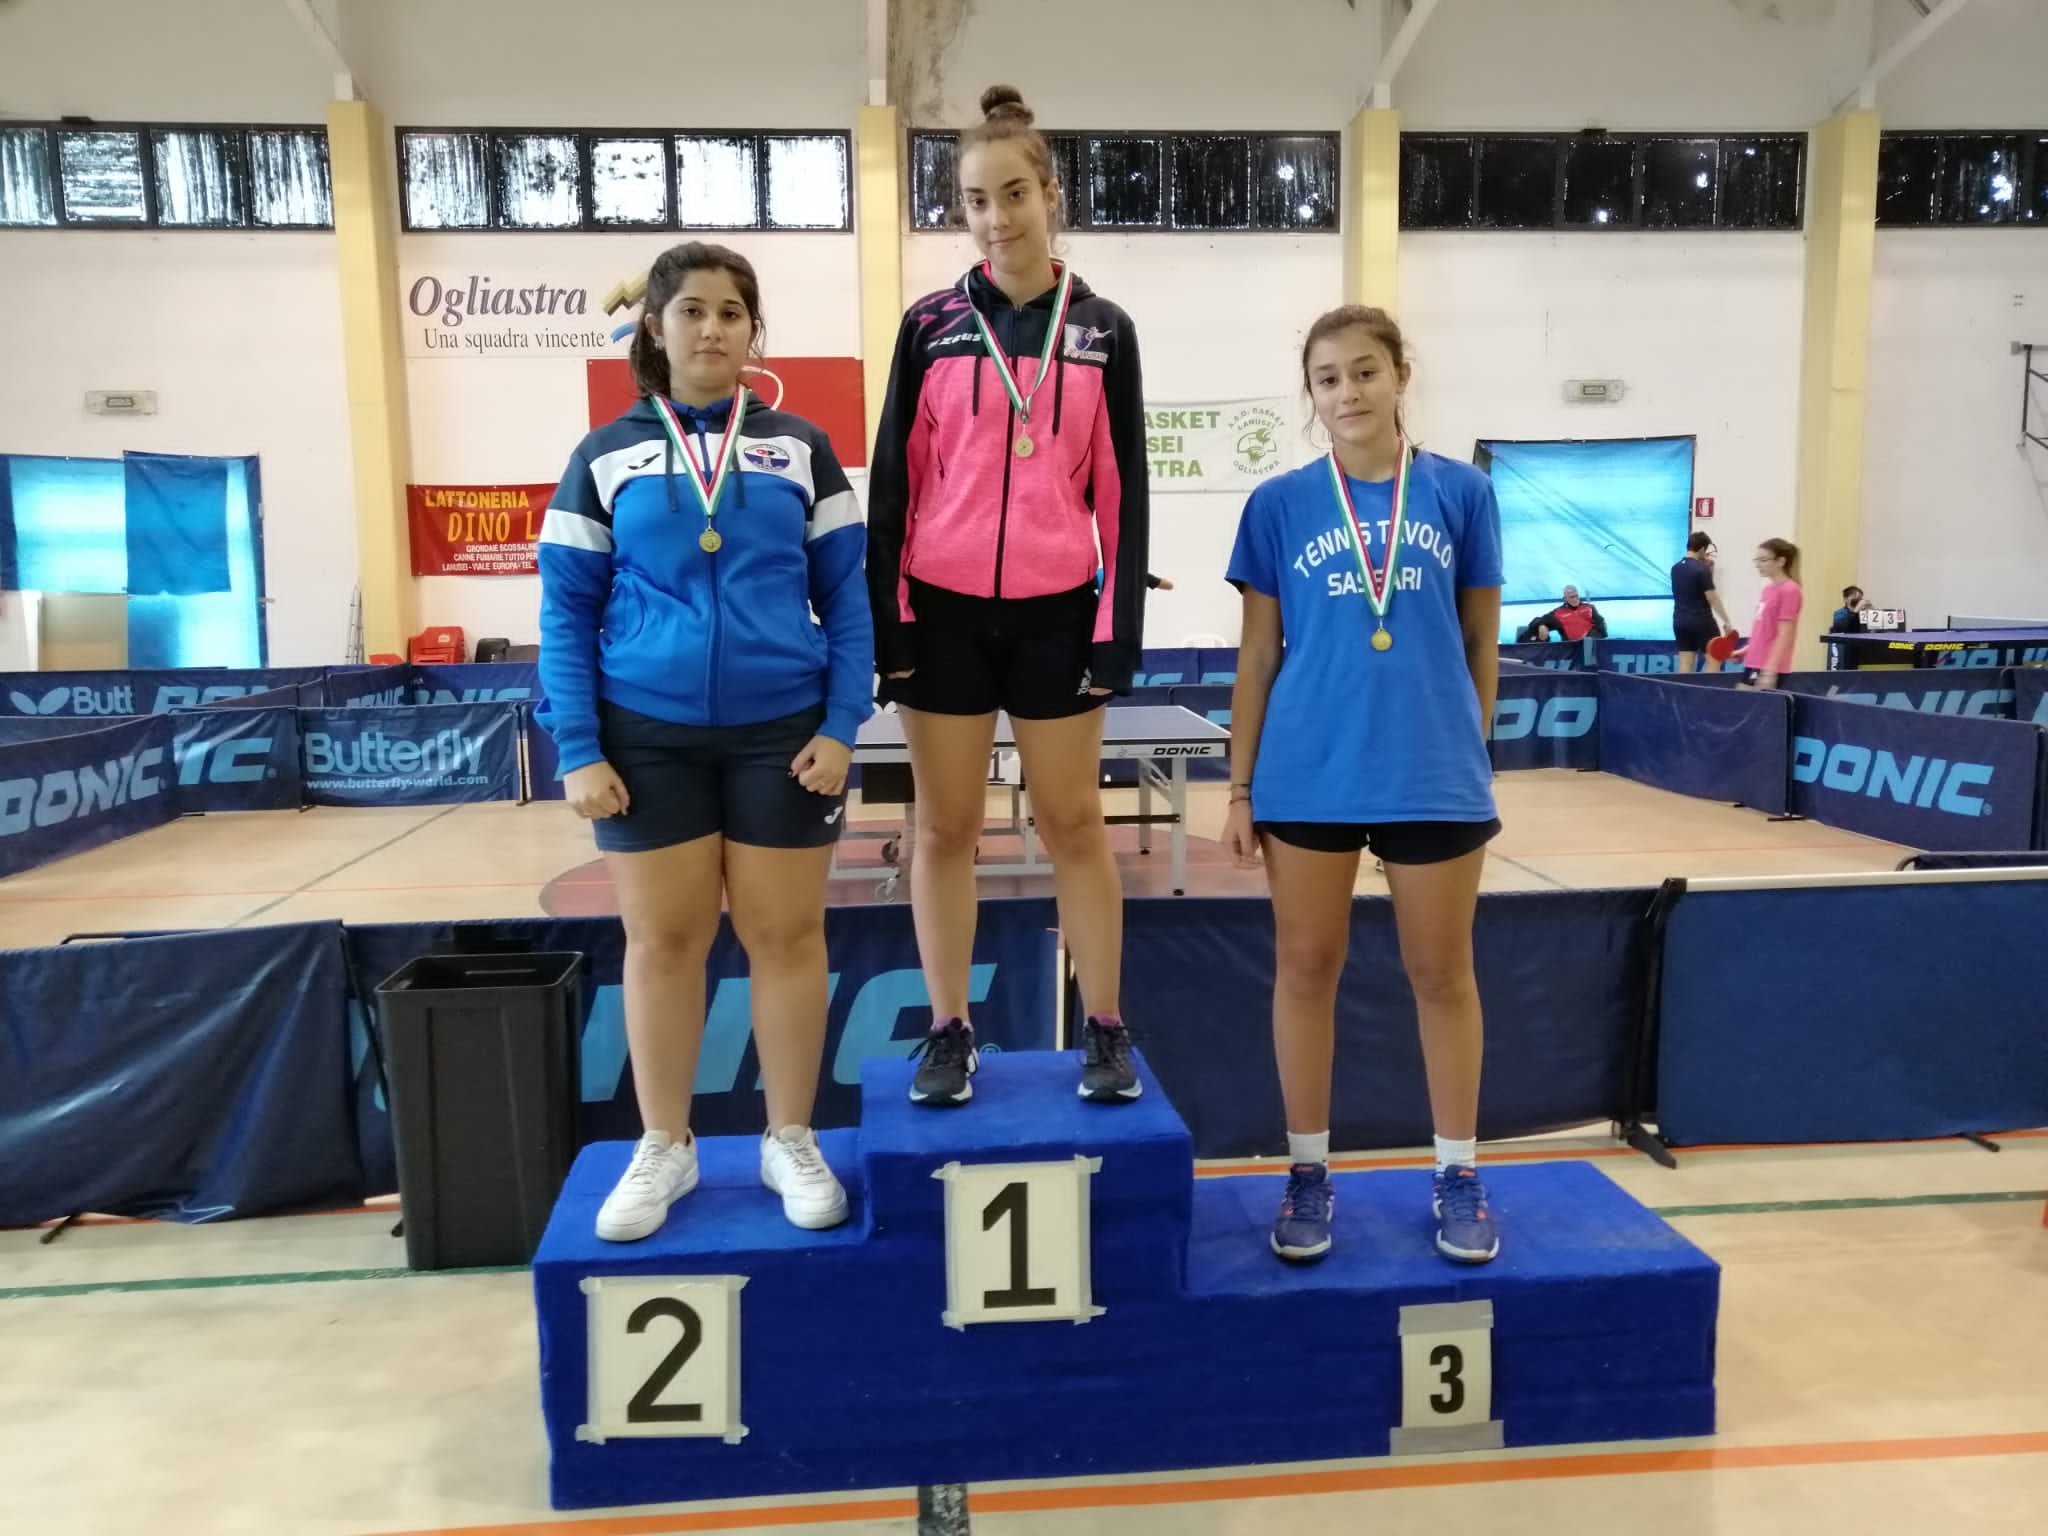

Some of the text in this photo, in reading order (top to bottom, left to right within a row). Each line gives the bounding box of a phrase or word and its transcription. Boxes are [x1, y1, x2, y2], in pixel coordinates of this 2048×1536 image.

[409, 276, 587, 326] Ogliastra
[425, 328, 606, 354] Una squadra vincente
[1148, 460, 1203, 477] TRA
[425, 490, 529, 509] LATTONERIA
[448, 511, 511, 542] DINO
[505, 552, 524, 560] TUTTO
[1293, 519, 1453, 579] TENNS TVOLO
[1872, 611, 1880, 623] 2
[1887, 612, 1894, 624] 3
[73, 686, 135, 715] Butt
[305, 729, 485, 776] Butterfly
[1153, 746, 1212, 756] DONIC
[1793, 736, 1995, 817] DONIC
[982, 1181, 1056, 1309] 1
[626, 1297, 702, 1423] 2
[1429, 1344, 1465, 1415] 3
